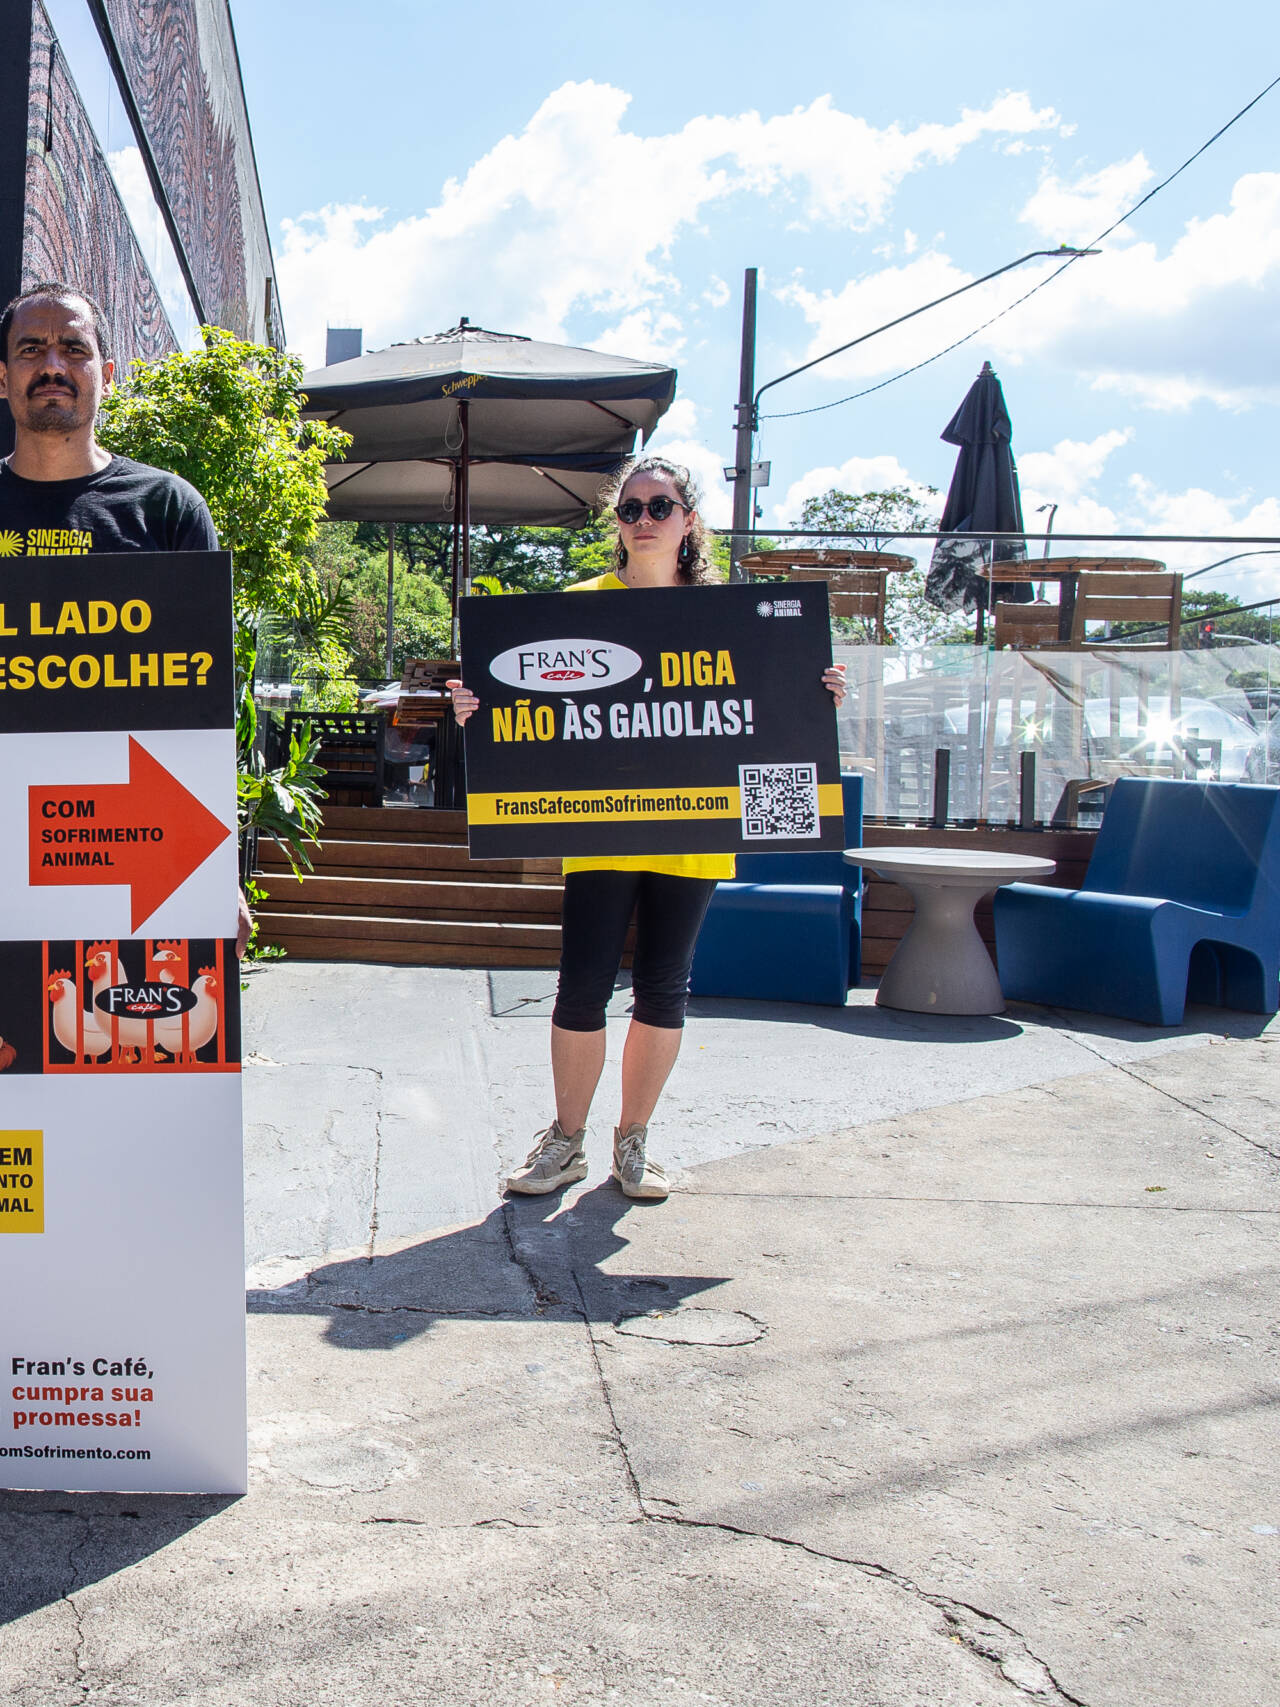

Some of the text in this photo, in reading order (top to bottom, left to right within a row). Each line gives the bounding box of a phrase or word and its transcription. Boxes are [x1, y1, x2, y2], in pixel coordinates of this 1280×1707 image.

[26, 528, 93, 548] SINERGIA
[773, 600, 802, 609] SINERGIA
[774, 608, 803, 617] ANIMAL
[30, 599, 152, 636] LADO
[518, 648, 610, 680] FRAN'S
[660, 650, 736, 687] DIGA
[492, 698, 754, 742] NÃO ÀS GAIOLAS!
[41, 799, 95, 818] COM
[495, 795, 729, 817] FransCafecomSofrimento.com
[41, 827, 164, 843] SOFRIMENTO
[41, 852, 115, 867] ANIMAL
[109, 987, 182, 1013] FRAN'S
[11, 1357, 155, 1379] Fran's Café,
[12, 1385, 154, 1405] cumpra sua
[13, 1409, 142, 1430] promessa!
